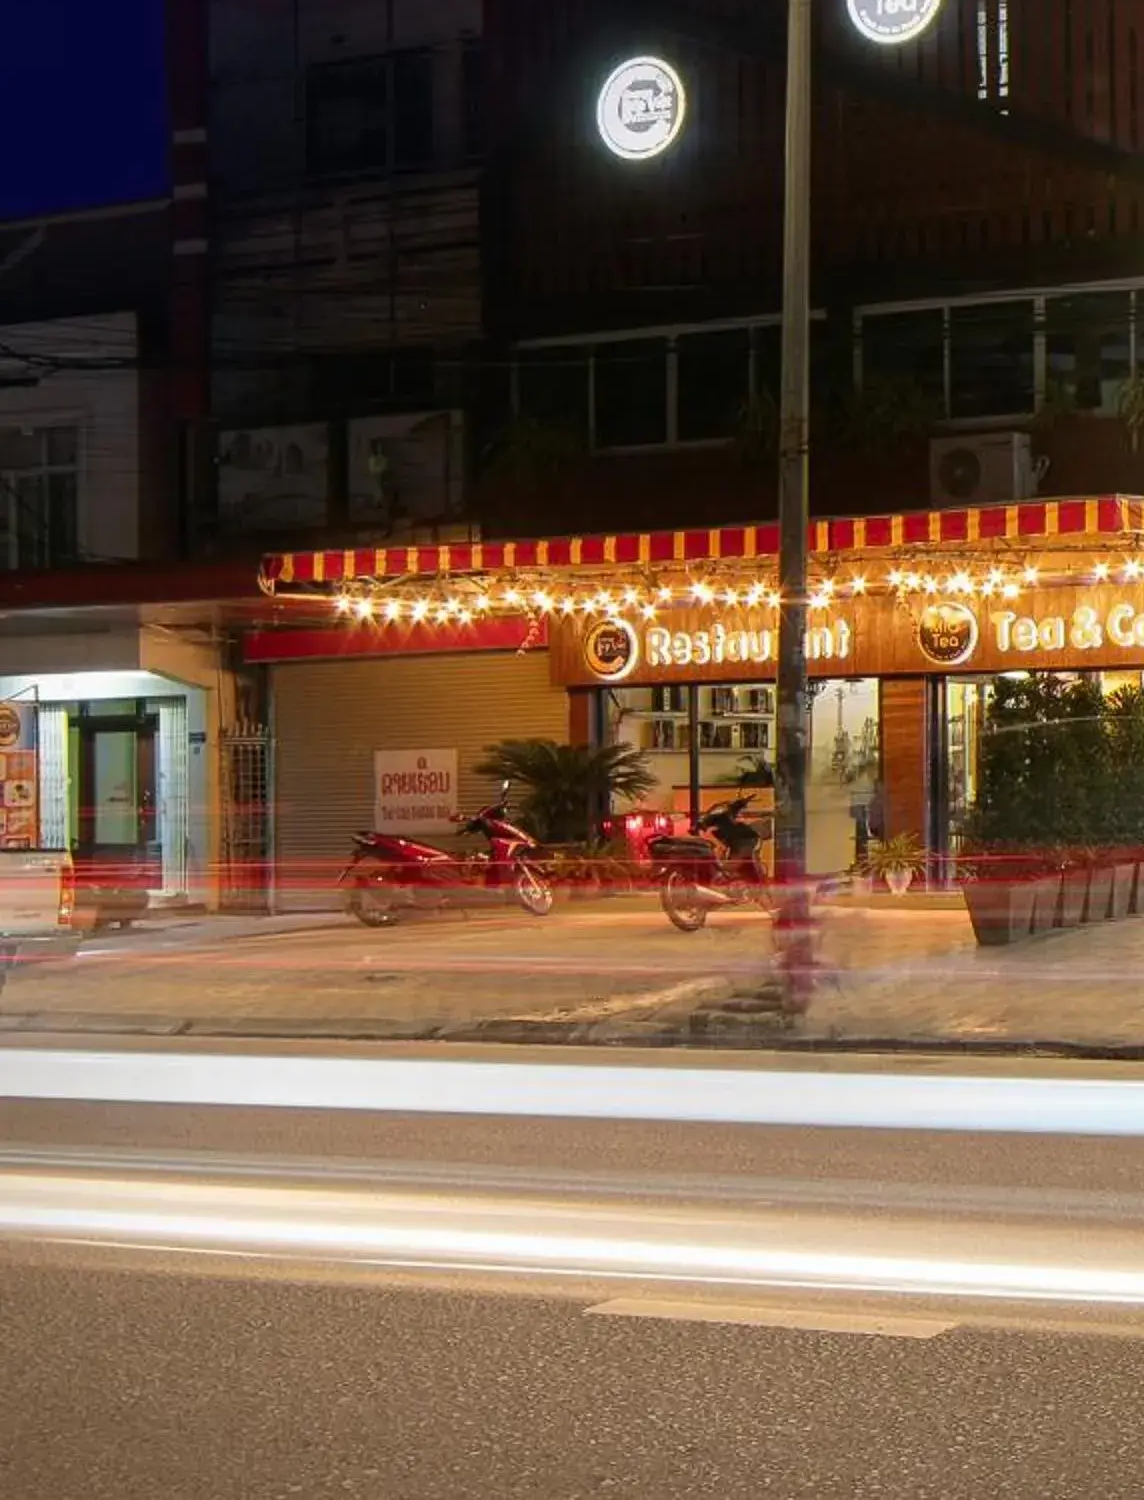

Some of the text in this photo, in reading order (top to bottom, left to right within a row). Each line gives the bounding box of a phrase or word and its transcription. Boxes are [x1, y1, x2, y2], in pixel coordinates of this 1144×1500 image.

[646, 619, 850, 666] Restaunt
[990, 610, 1065, 652] Tea
[1069, 605, 1103, 650] &
